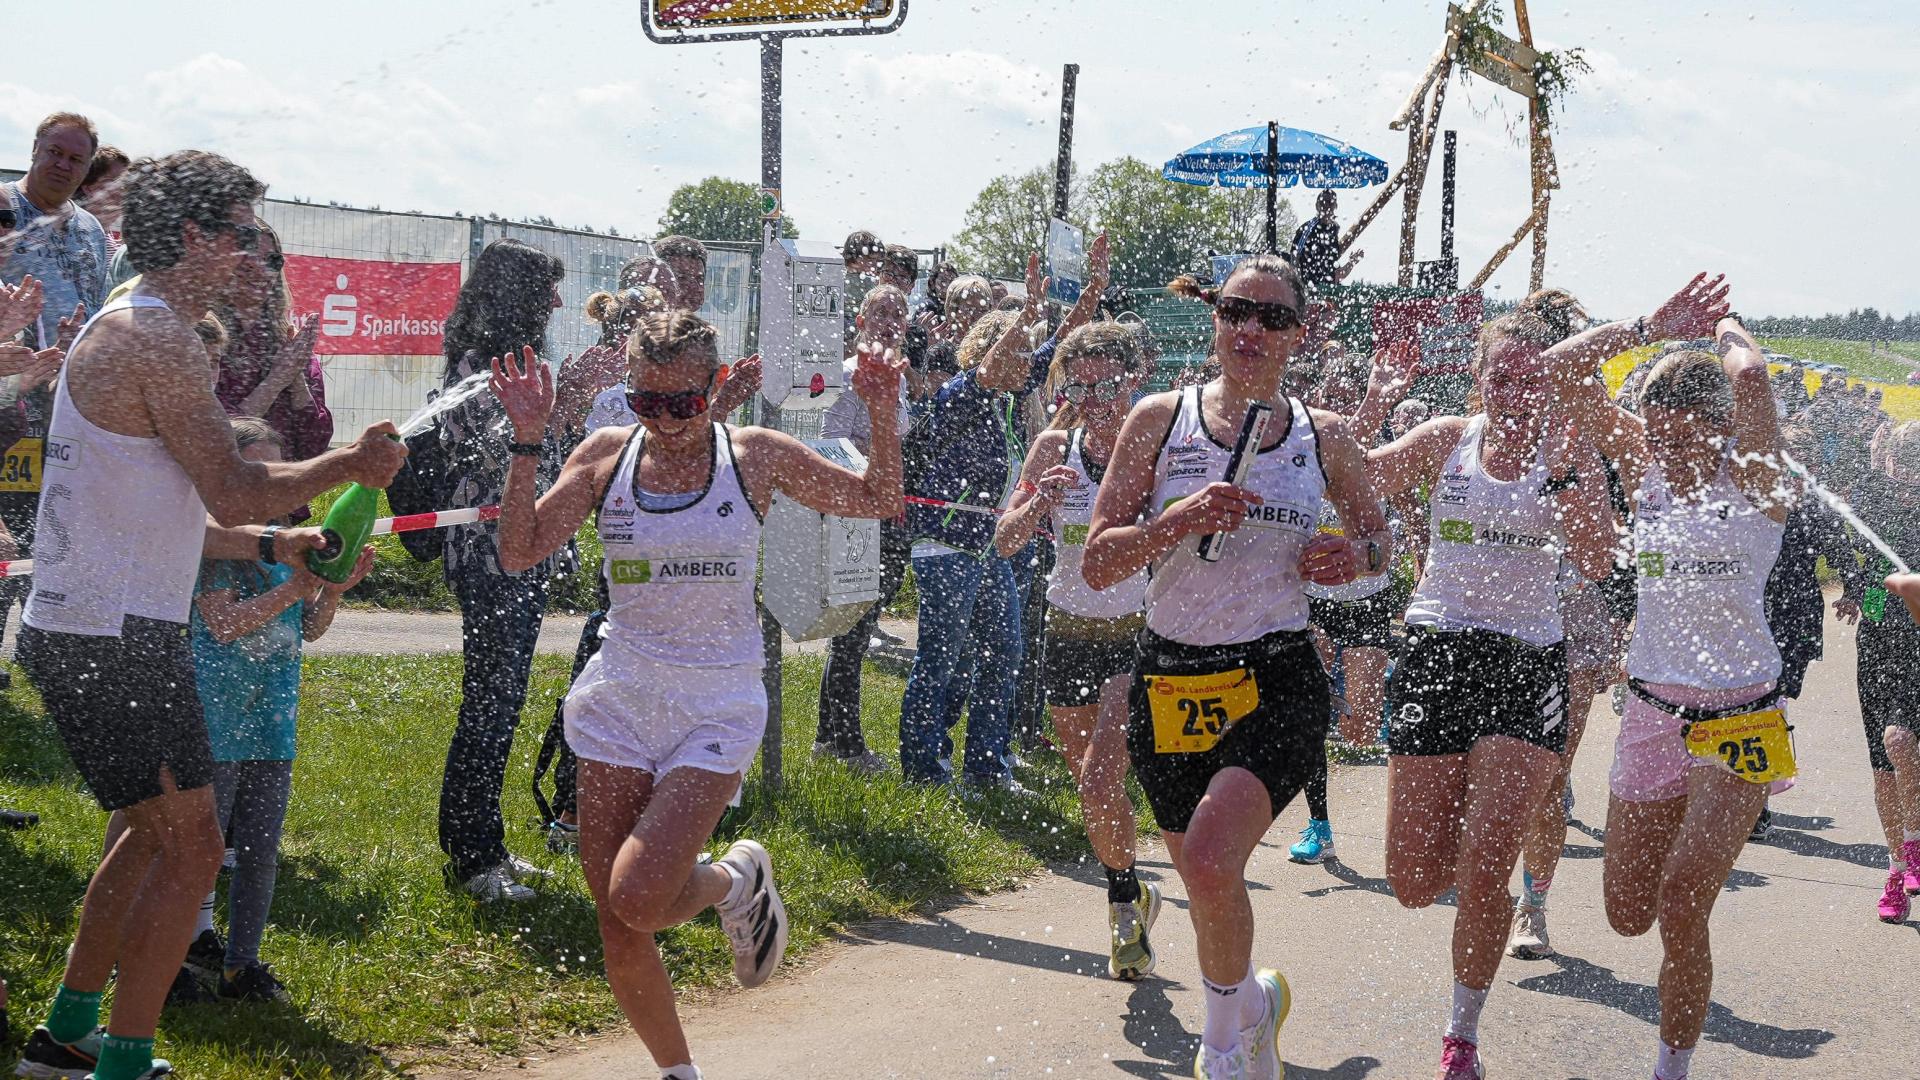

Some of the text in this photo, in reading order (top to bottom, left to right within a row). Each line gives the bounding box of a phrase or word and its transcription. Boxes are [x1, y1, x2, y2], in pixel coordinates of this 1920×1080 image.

[0, 455, 32, 482] 34
[1245, 506, 1310, 529] MBERG
[659, 562, 737, 577] AMBERG
[1177, 697, 1229, 737] 25
[1718, 736, 1769, 774] 25
